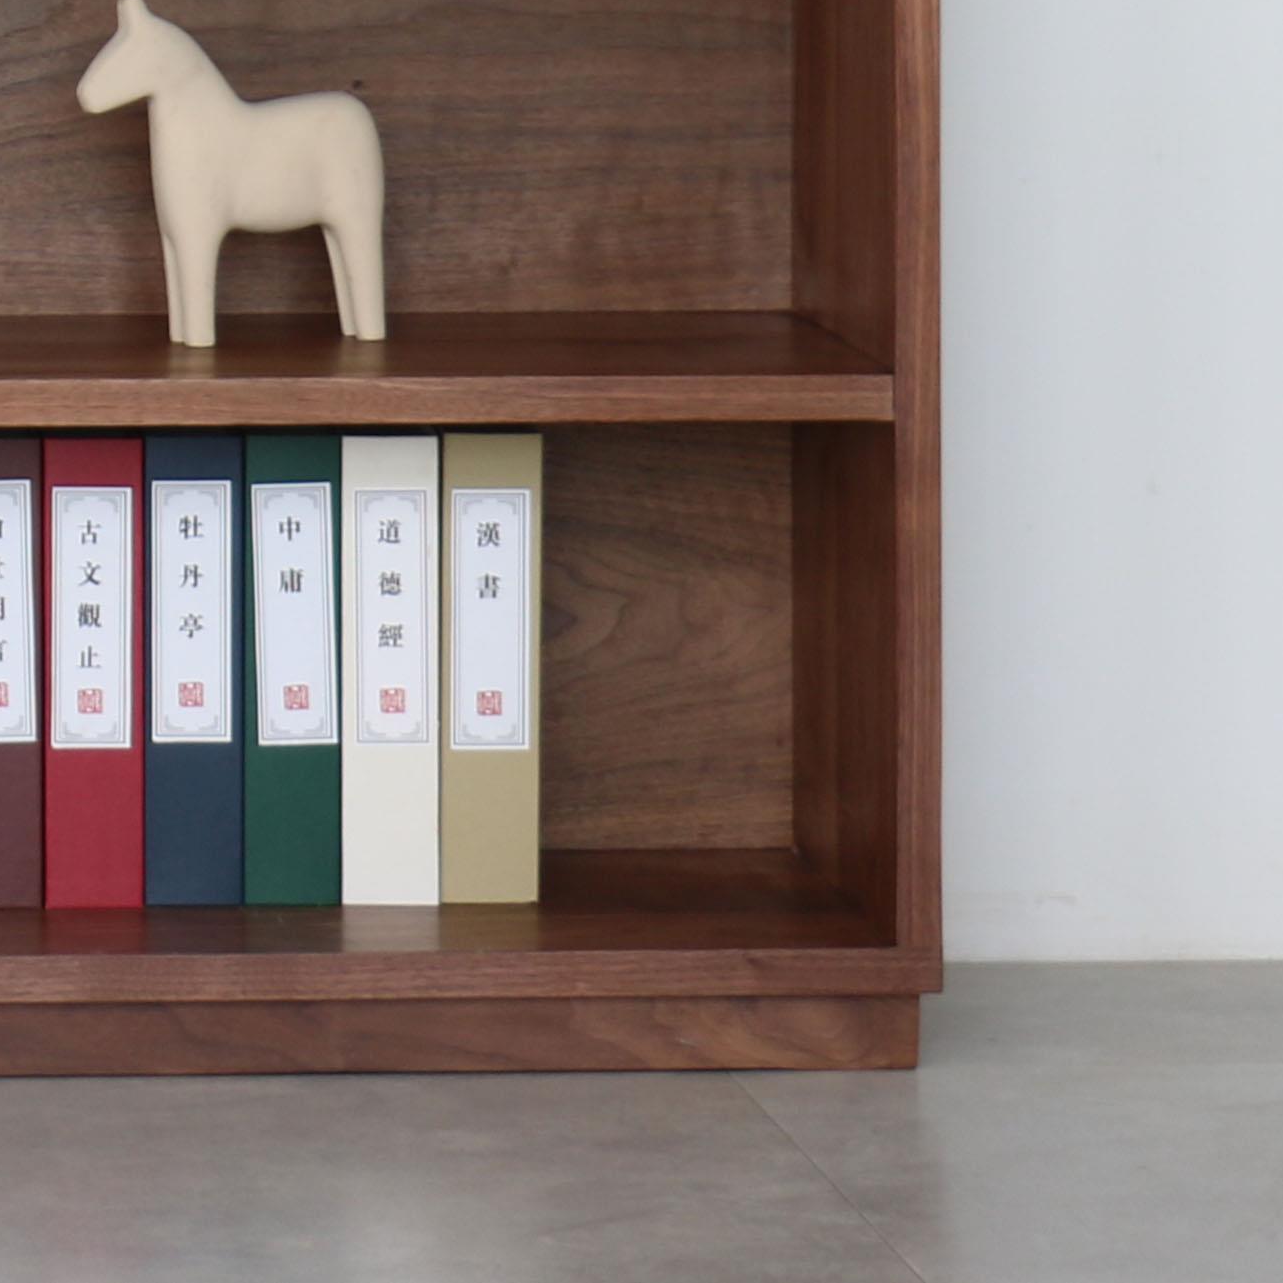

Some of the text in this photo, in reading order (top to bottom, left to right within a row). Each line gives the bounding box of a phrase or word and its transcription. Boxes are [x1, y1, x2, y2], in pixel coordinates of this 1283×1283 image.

[77, 520, 102, 671] 古文觀止
[178, 515, 204, 640] 牡丹亭
[278, 516, 304, 595] 中庸
[377, 519, 405, 648] 道德經
[475, 522, 502, 599] 漢書
